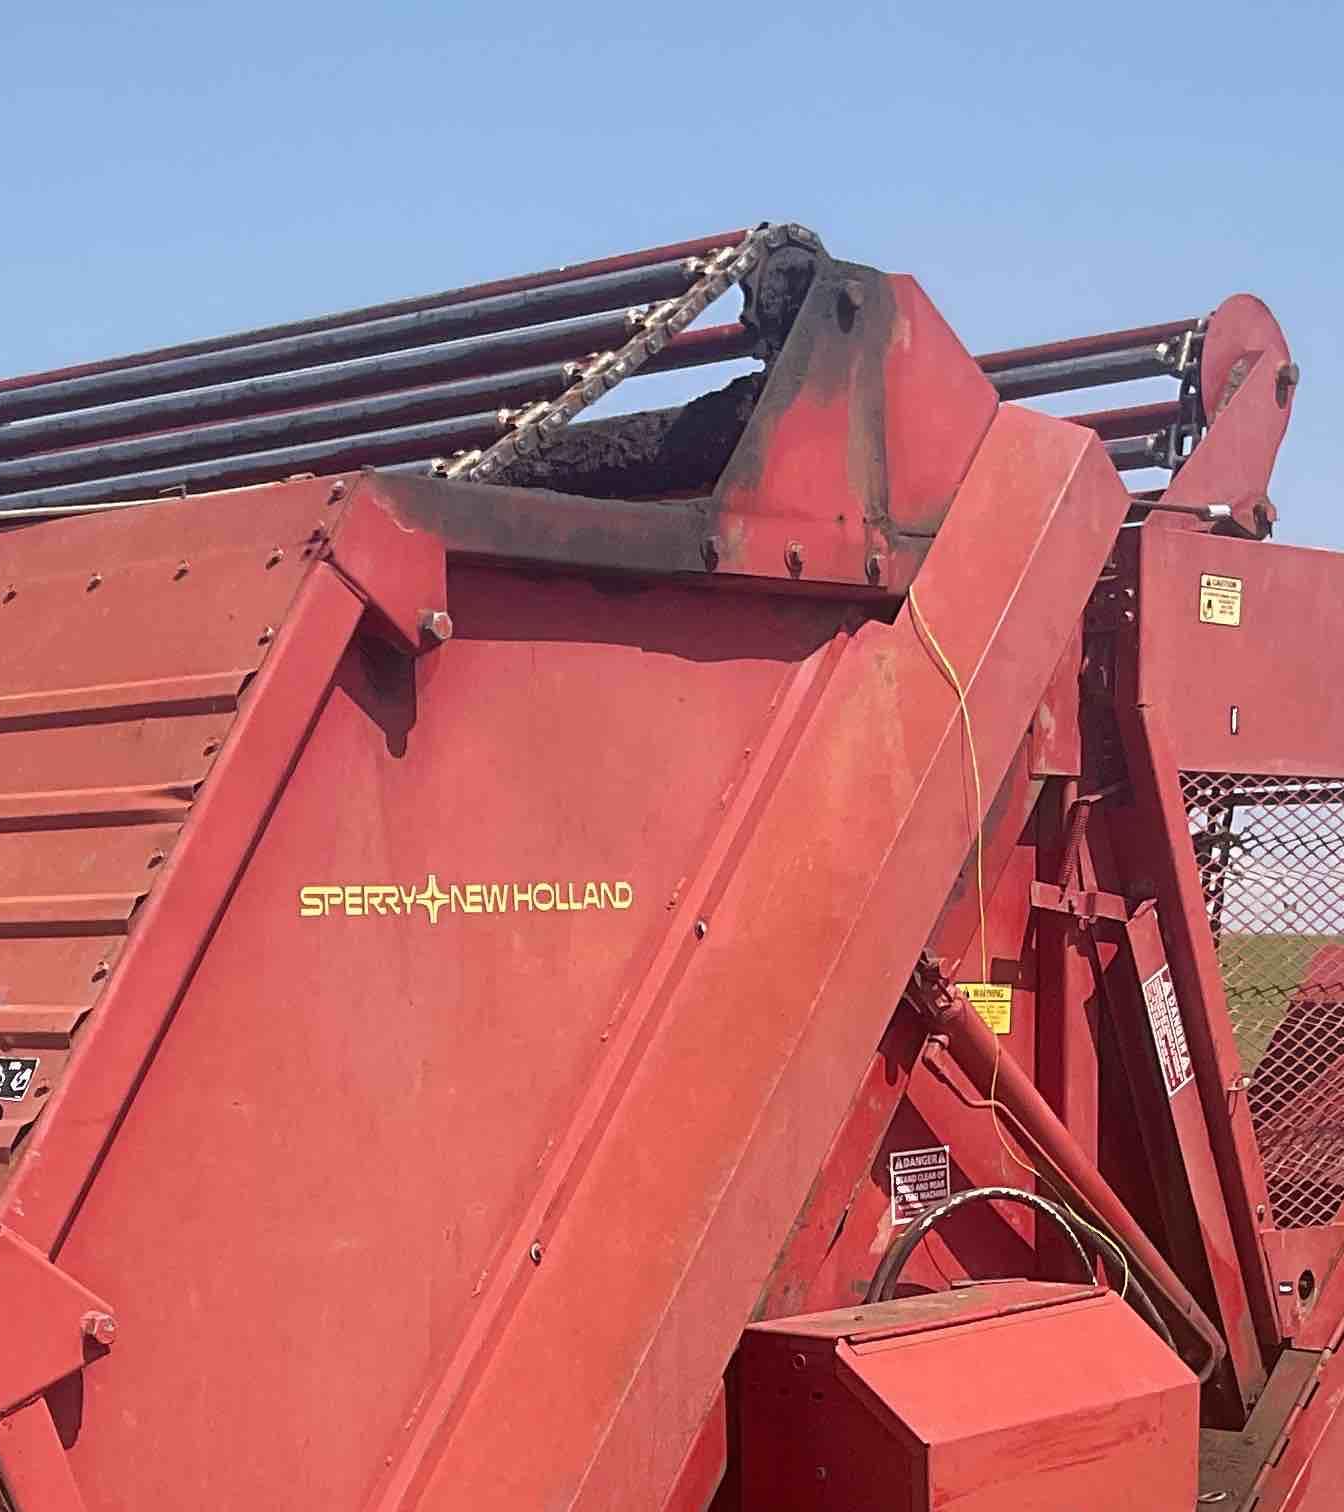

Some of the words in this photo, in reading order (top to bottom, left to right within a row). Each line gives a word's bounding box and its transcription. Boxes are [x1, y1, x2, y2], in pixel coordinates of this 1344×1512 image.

[300, 885, 417, 916] SPERRY
[449, 884, 509, 913] NEW
[513, 881, 633, 911] HOLLAND
[904, 1154, 938, 1168] DANGER
